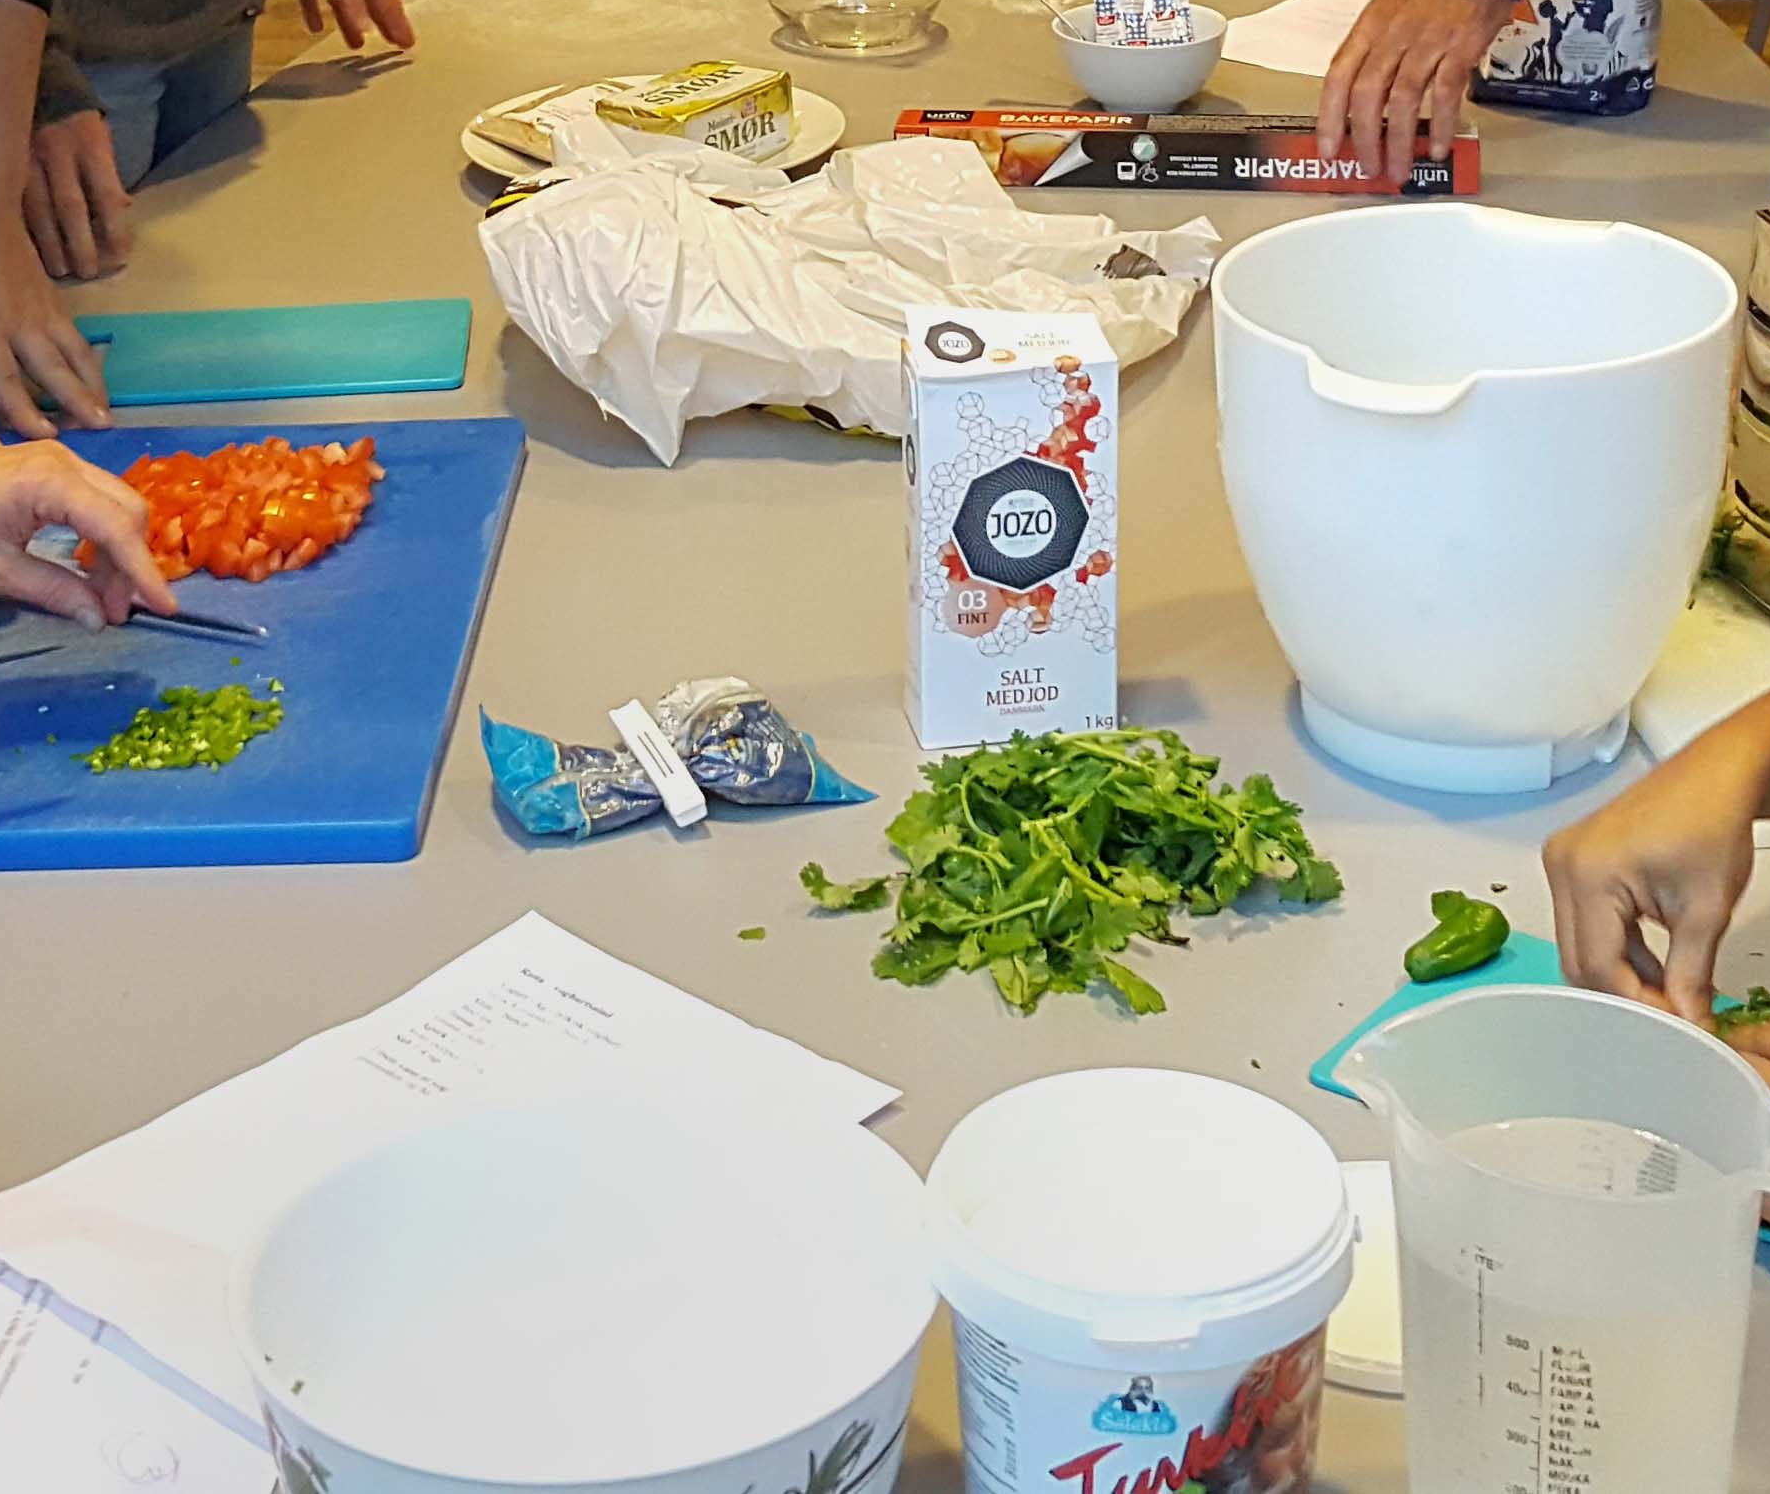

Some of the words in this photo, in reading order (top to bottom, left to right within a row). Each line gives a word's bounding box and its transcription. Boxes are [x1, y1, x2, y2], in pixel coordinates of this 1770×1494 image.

[644, 67, 745, 106] SMØR
[998, 113, 1134, 125] BAKEPAPIR
[704, 110, 777, 153] SMØR
[990, 508, 1053, 539] JOZO
[957, 590, 987, 610] 03
[957, 612, 989, 625] FINT
[1000, 667, 1046, 687] SALT
[986, 688, 1025, 706] MED
[1026, 686, 1059, 703] JOD
[1084, 715, 1091, 730] 1
[1095, 714, 1113, 731] kg
